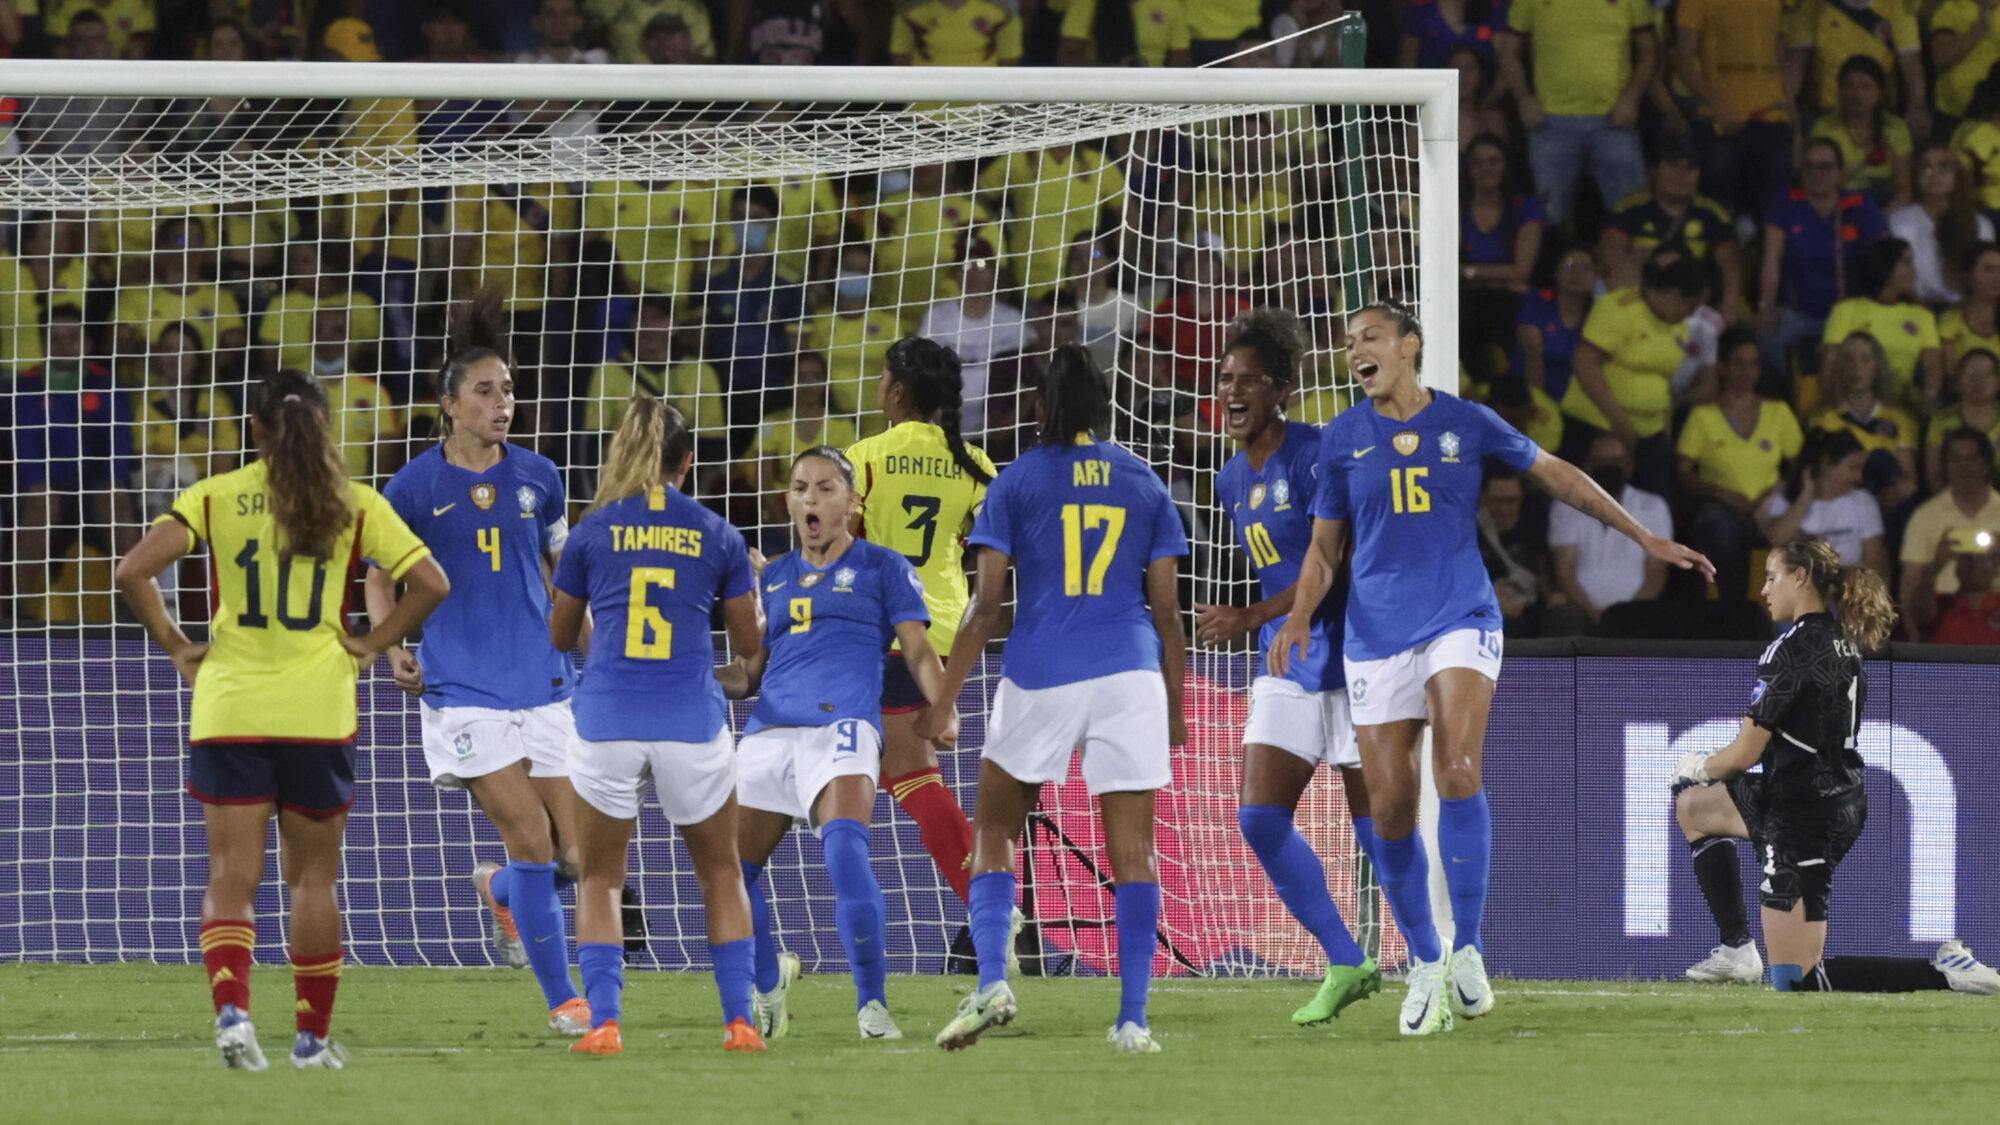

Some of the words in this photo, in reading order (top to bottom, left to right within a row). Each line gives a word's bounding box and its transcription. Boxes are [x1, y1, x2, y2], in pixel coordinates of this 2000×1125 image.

[886, 455, 962, 479] DANIELA
[1073, 459, 1111, 487] ARY
[1390, 467, 1431, 513] 16
[477, 527, 501, 571] 4
[609, 525, 703, 558] TAMIRES
[902, 495, 941, 567] 3
[1060, 504, 1127, 596] 17
[1244, 522, 1281, 569] 10
[234, 539, 327, 631] 10
[624, 567, 676, 660] 6
[789, 597, 812, 635] 9
[1843, 675, 1857, 749] 1
[836, 720, 858, 753] 9
